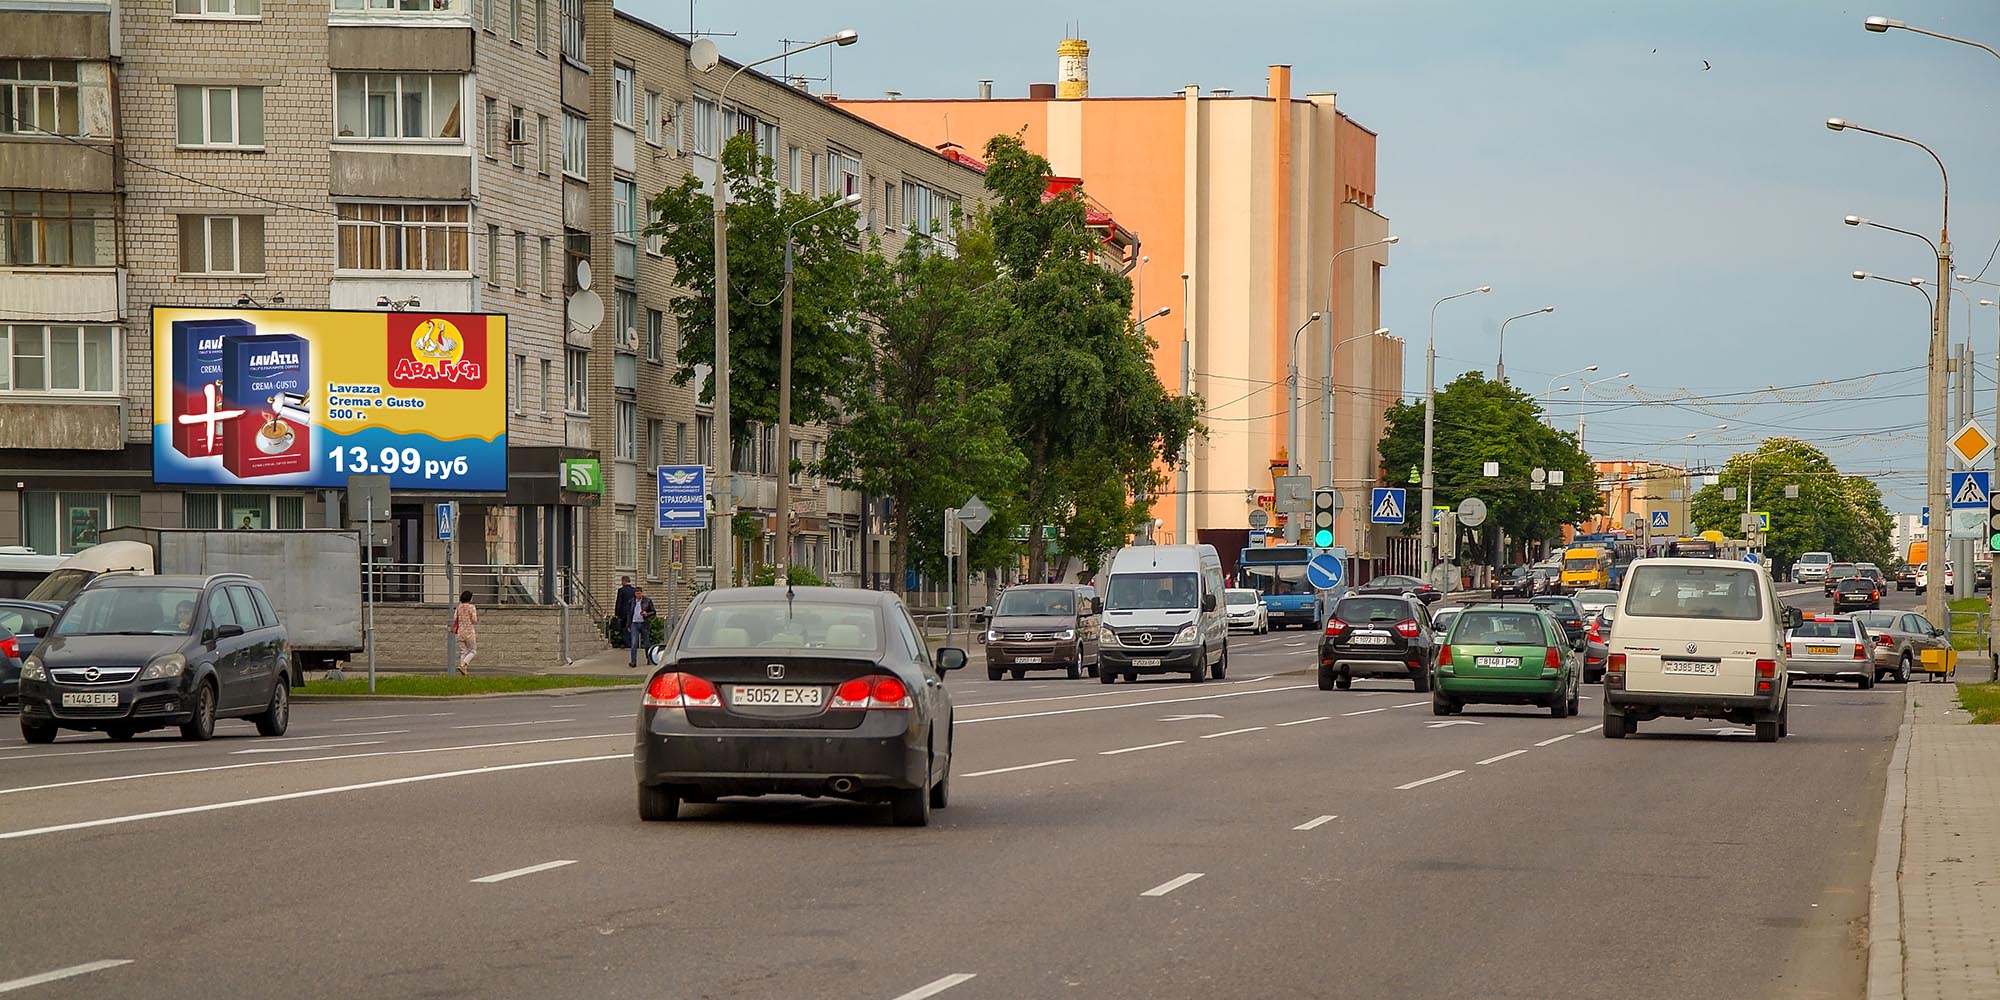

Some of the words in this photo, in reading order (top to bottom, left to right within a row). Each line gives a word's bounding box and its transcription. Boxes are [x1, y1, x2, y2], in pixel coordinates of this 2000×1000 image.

[250, 350, 299, 367] LAVAZZA
[251, 382, 273, 391] CREMA
[276, 380, 298, 390] GUSTO
[329, 383, 380, 394] Lavazza
[329, 396, 371, 406] Crema
[375, 398, 383, 407] e
[387, 397, 424, 408] Gusto
[329, 409, 353, 419] 500
[328, 446, 421, 474] 13.99
[425, 455, 468, 480] руб
[660, 495, 703, 504] СТРАХОВАНИЕ
[1694, 664, 1715, 673] BE-3
[72, 694, 92, 704] 1443
[747, 688, 779, 703] 5052
[784, 689, 819, 703] EX-3
